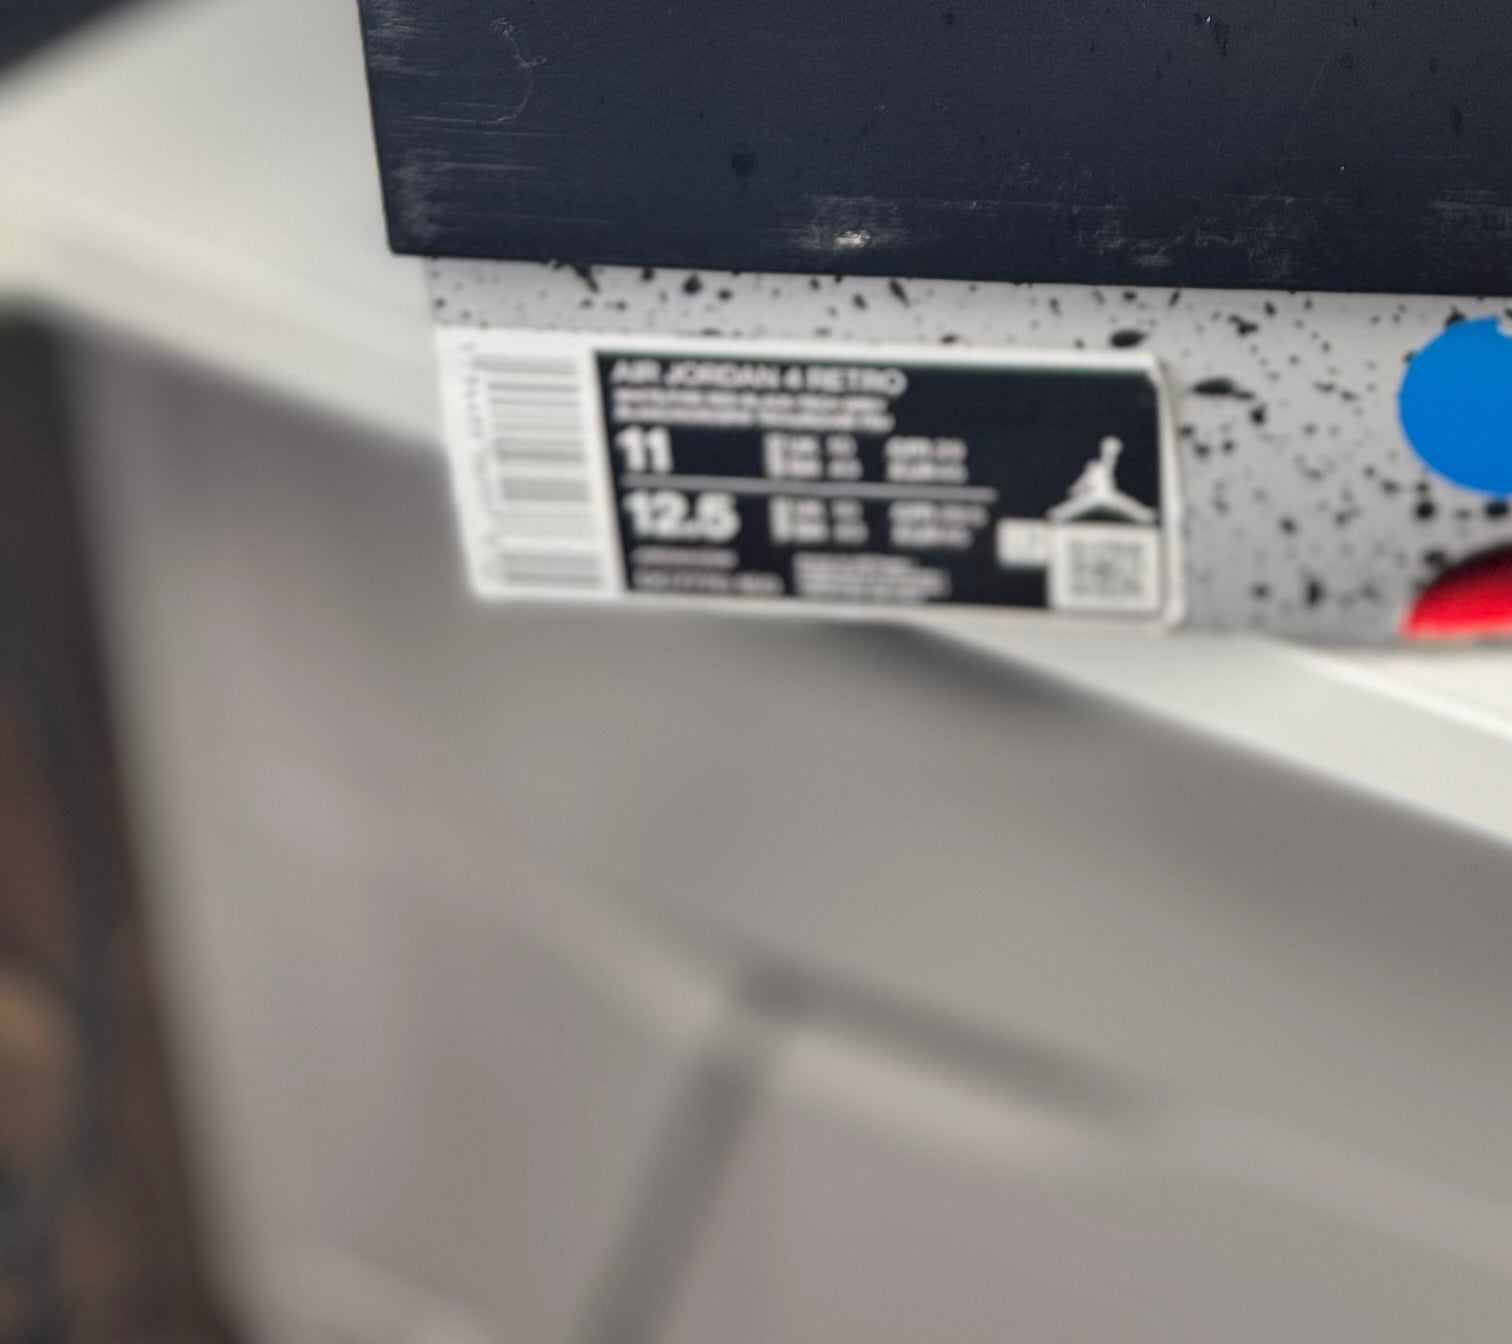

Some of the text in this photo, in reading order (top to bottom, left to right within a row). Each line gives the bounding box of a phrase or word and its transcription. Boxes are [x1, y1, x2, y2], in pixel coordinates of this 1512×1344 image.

[611, 359, 662, 385] AIR
[666, 361, 779, 389] JORDAN
[807, 368, 908, 395] RETRO
[614, 426, 673, 473] 11
[623, 492, 741, 543] 12.5
